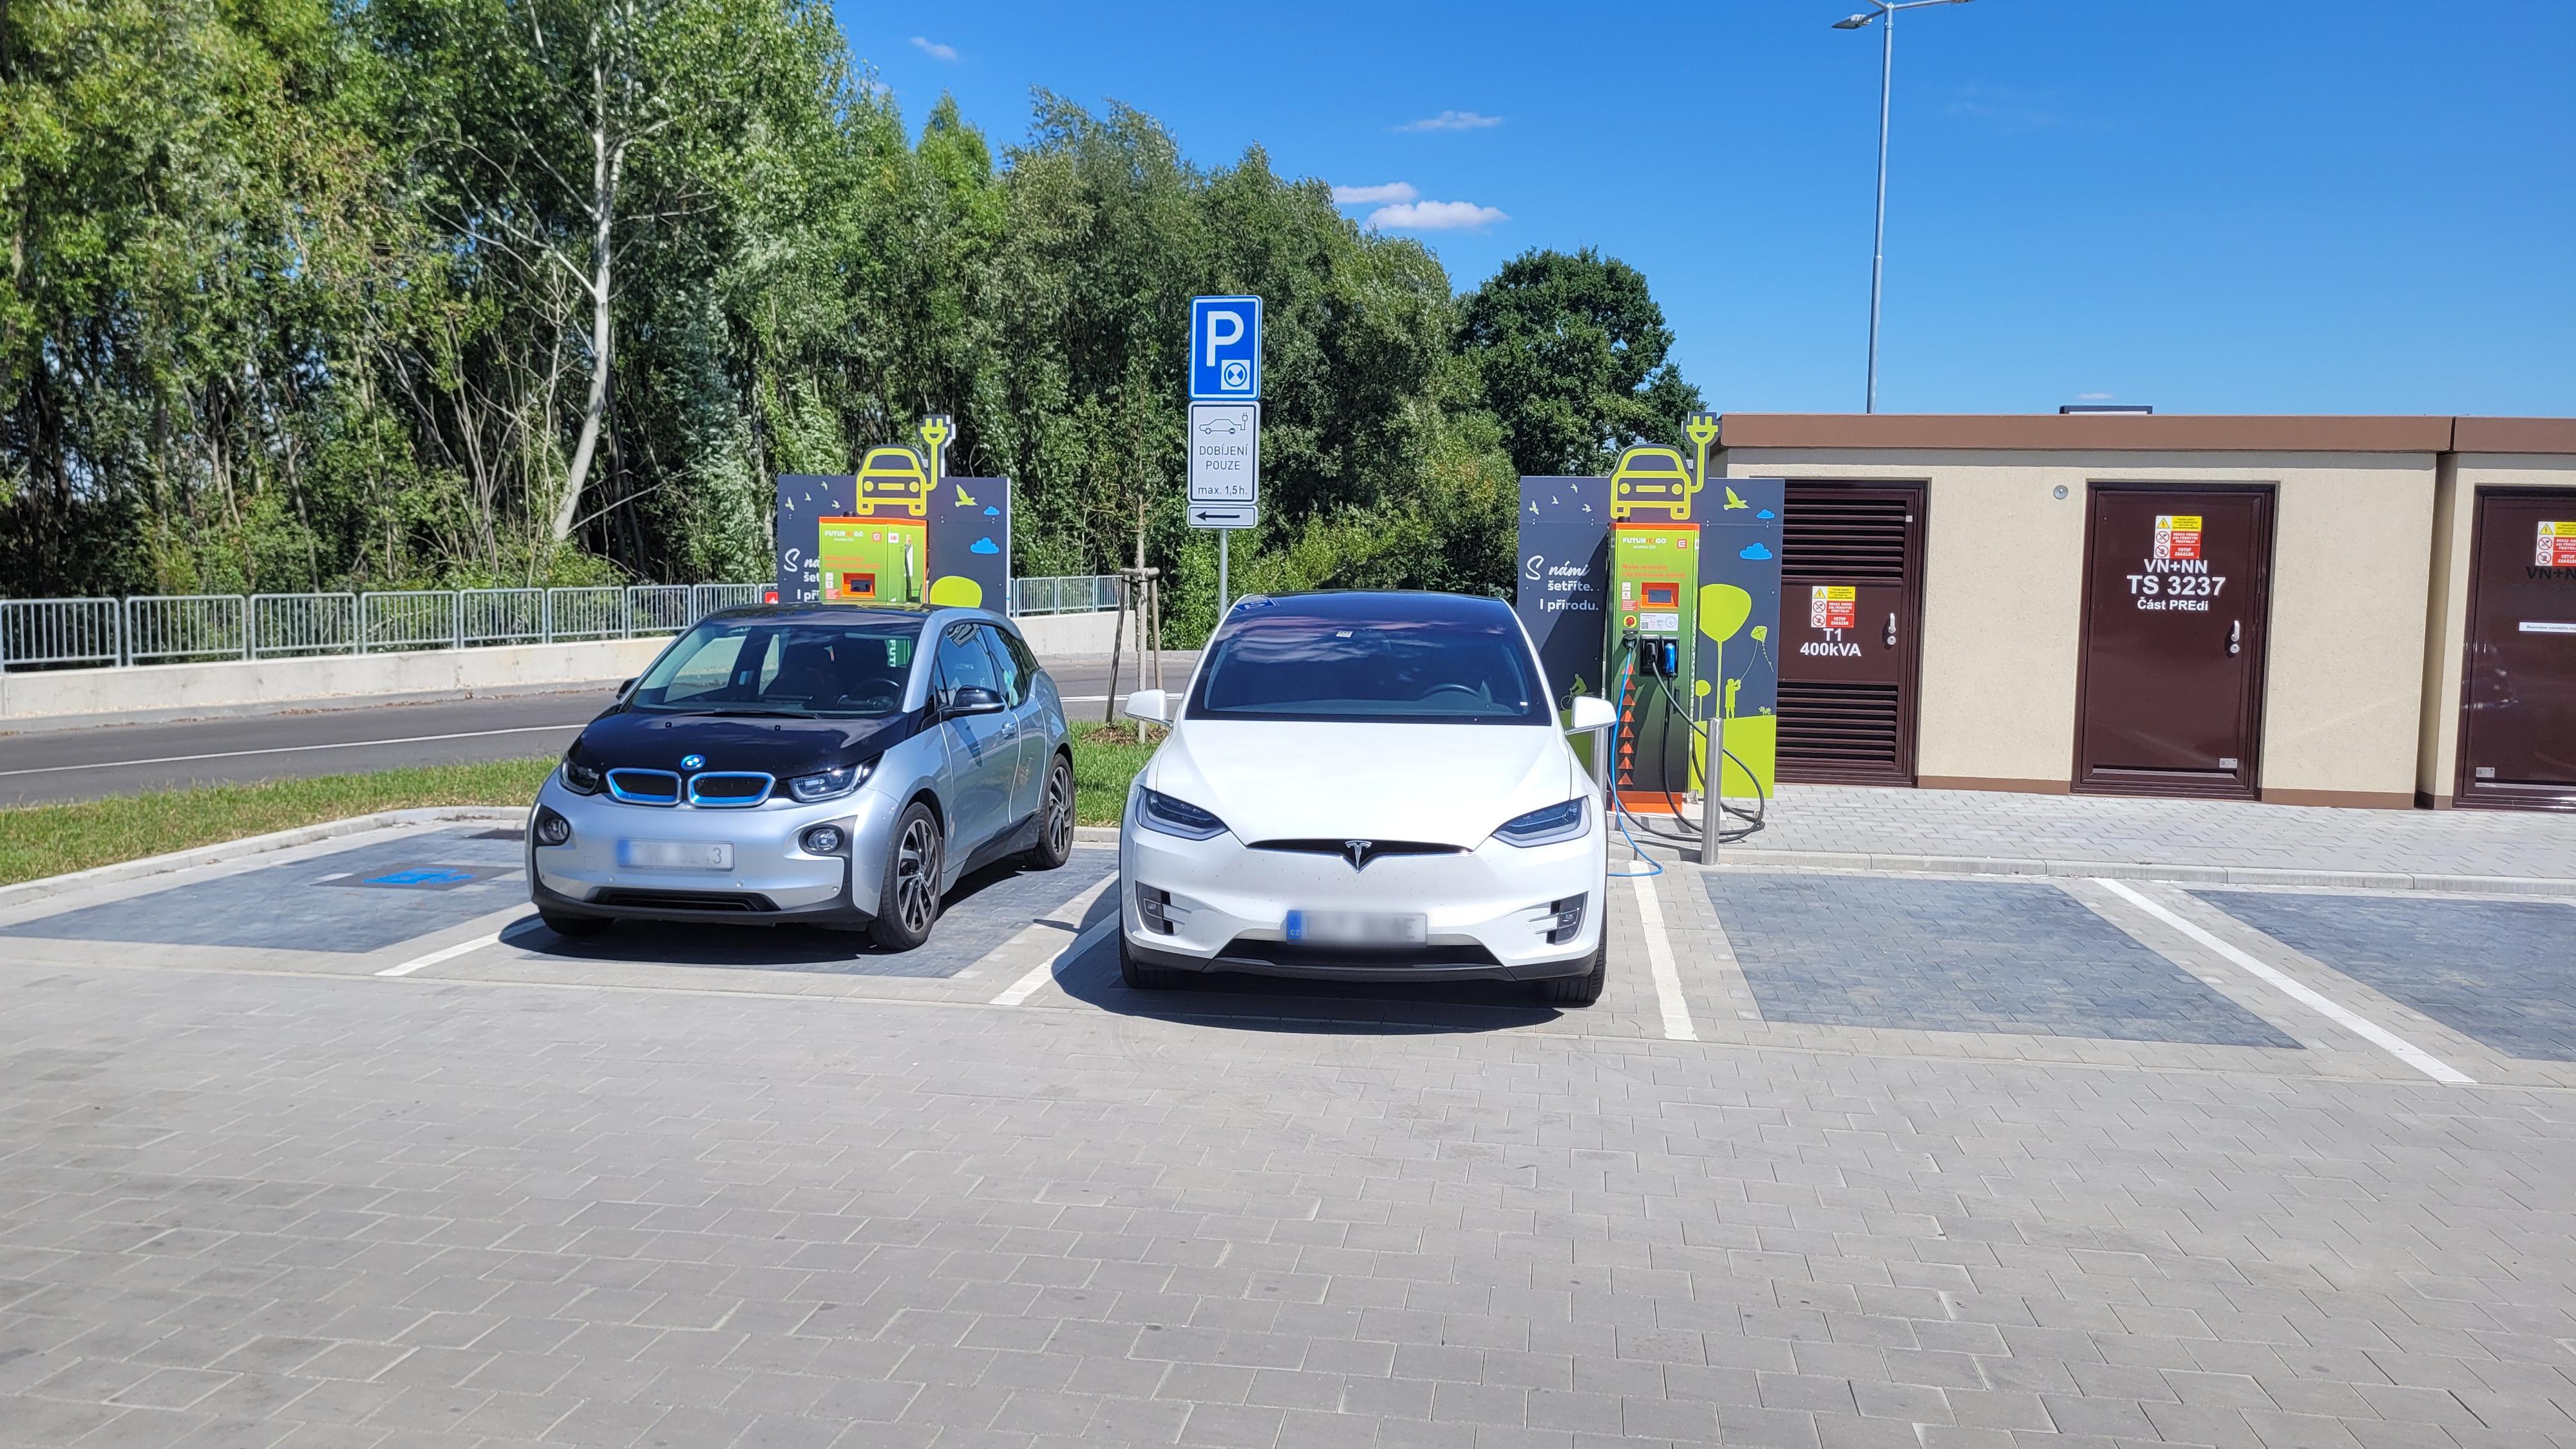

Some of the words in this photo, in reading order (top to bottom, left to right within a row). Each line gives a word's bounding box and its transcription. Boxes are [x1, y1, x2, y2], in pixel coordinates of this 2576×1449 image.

[1206, 310, 1244, 367] P
[1199, 444, 1249, 456] DOBÍJENÍ
[1206, 460, 1241, 470] POUZE
[784, 548, 800, 573] S
[1526, 555, 1544, 581] S
[1549, 560, 1591, 576] námi
[2144, 559, 2207, 574] VN+NN
[1548, 580, 1593, 591] šetříte.
[2126, 575, 2159, 594] TS
[2167, 576, 2226, 596] 3237
[1540, 598, 1544, 610] I
[1548, 599, 1599, 612] přírodu.
[2137, 596, 2166, 610] Část
[2169, 600, 2208, 611] PREdi
[1823, 628, 1841, 641] T1
[1800, 642, 1862, 657] 400kVA
